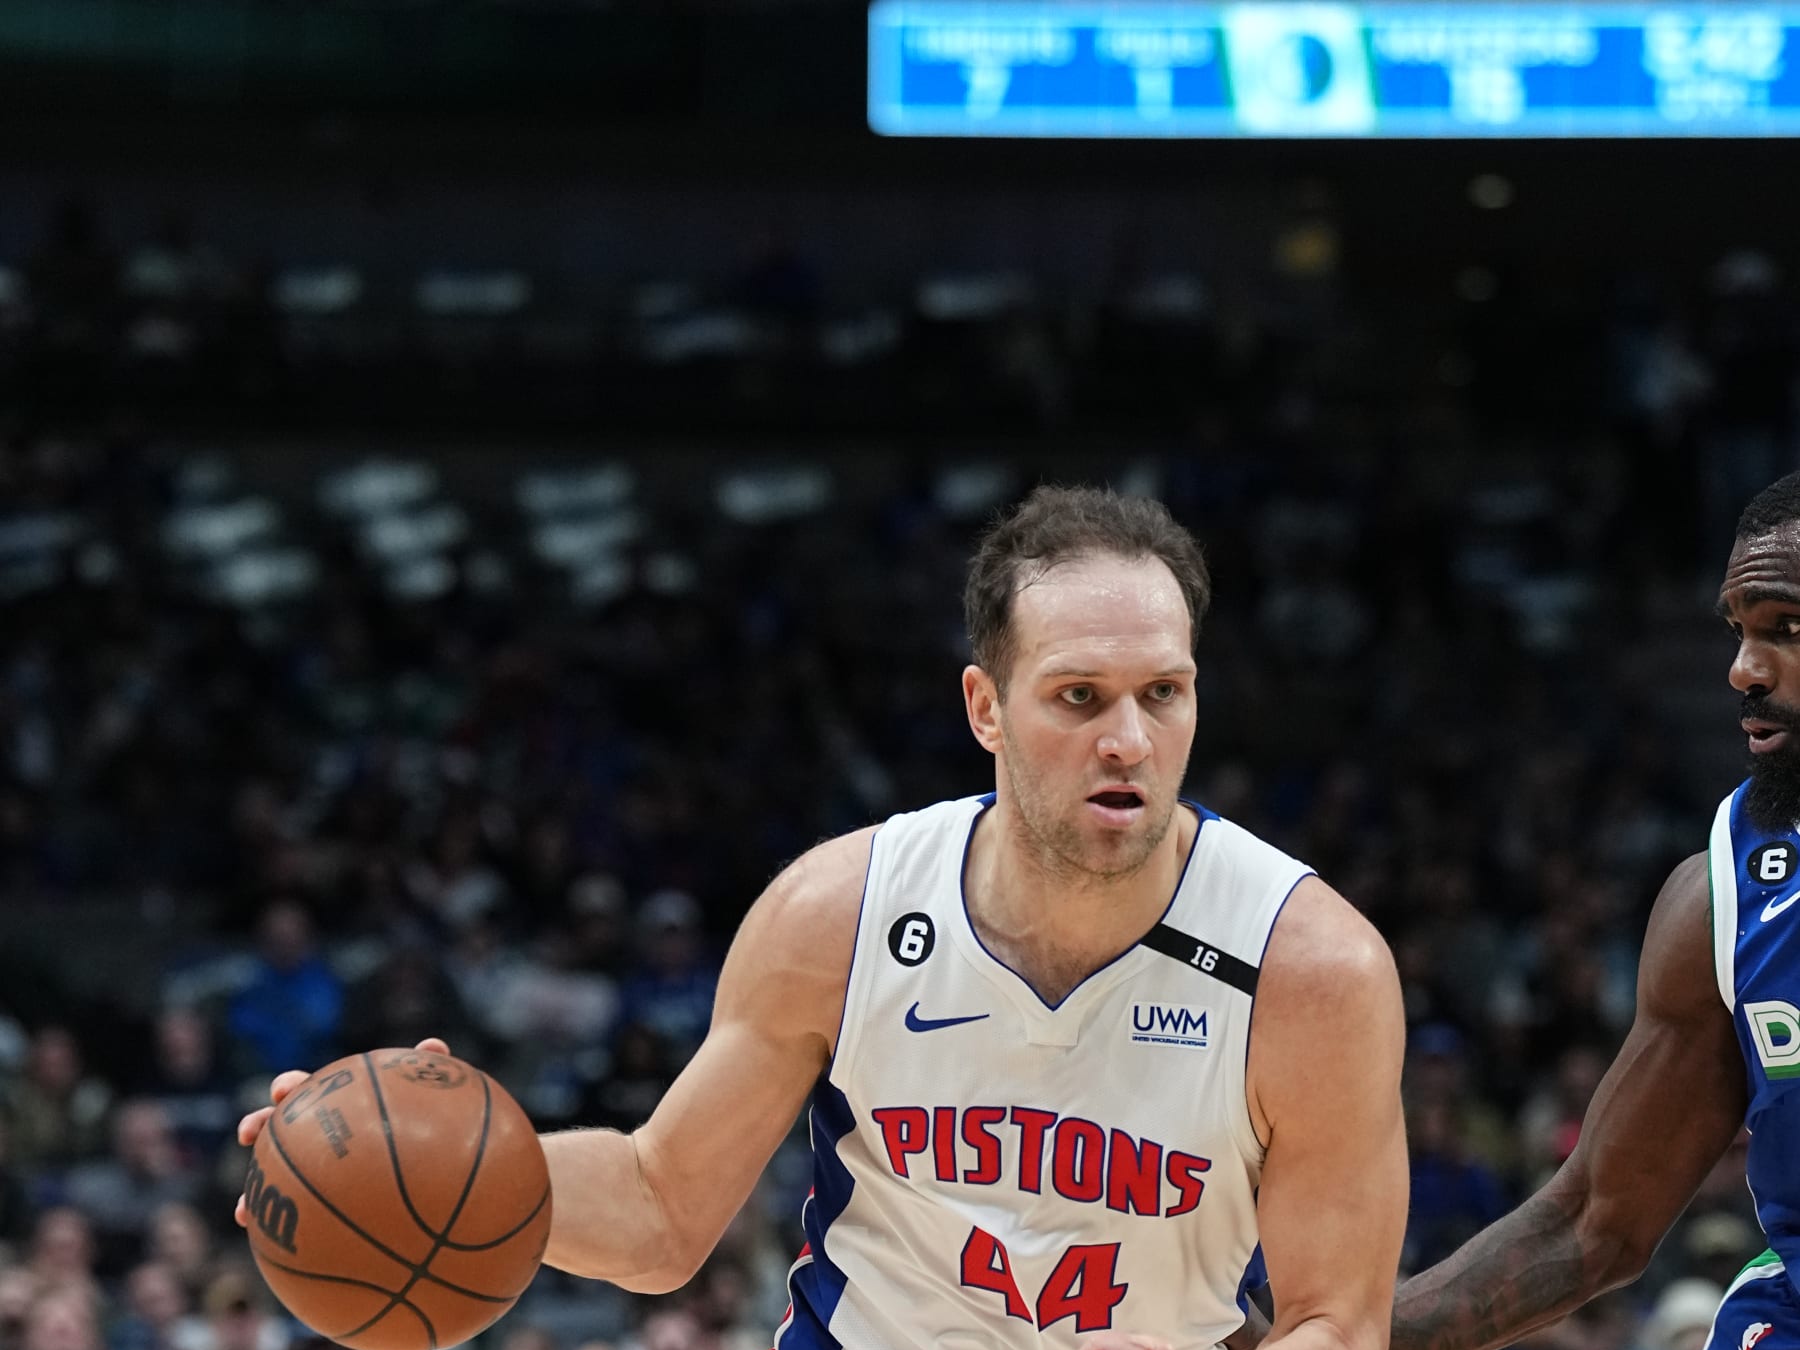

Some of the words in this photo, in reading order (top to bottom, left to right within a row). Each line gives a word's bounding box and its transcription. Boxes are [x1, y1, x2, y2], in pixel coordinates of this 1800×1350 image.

[1759, 846, 1788, 881] 6
[898, 920, 929, 962] 6
[1190, 945, 1220, 972] 16
[1133, 1005, 1208, 1037] UWM
[872, 1105, 1212, 1218] PISTONS
[960, 1225, 1129, 1334] 44
